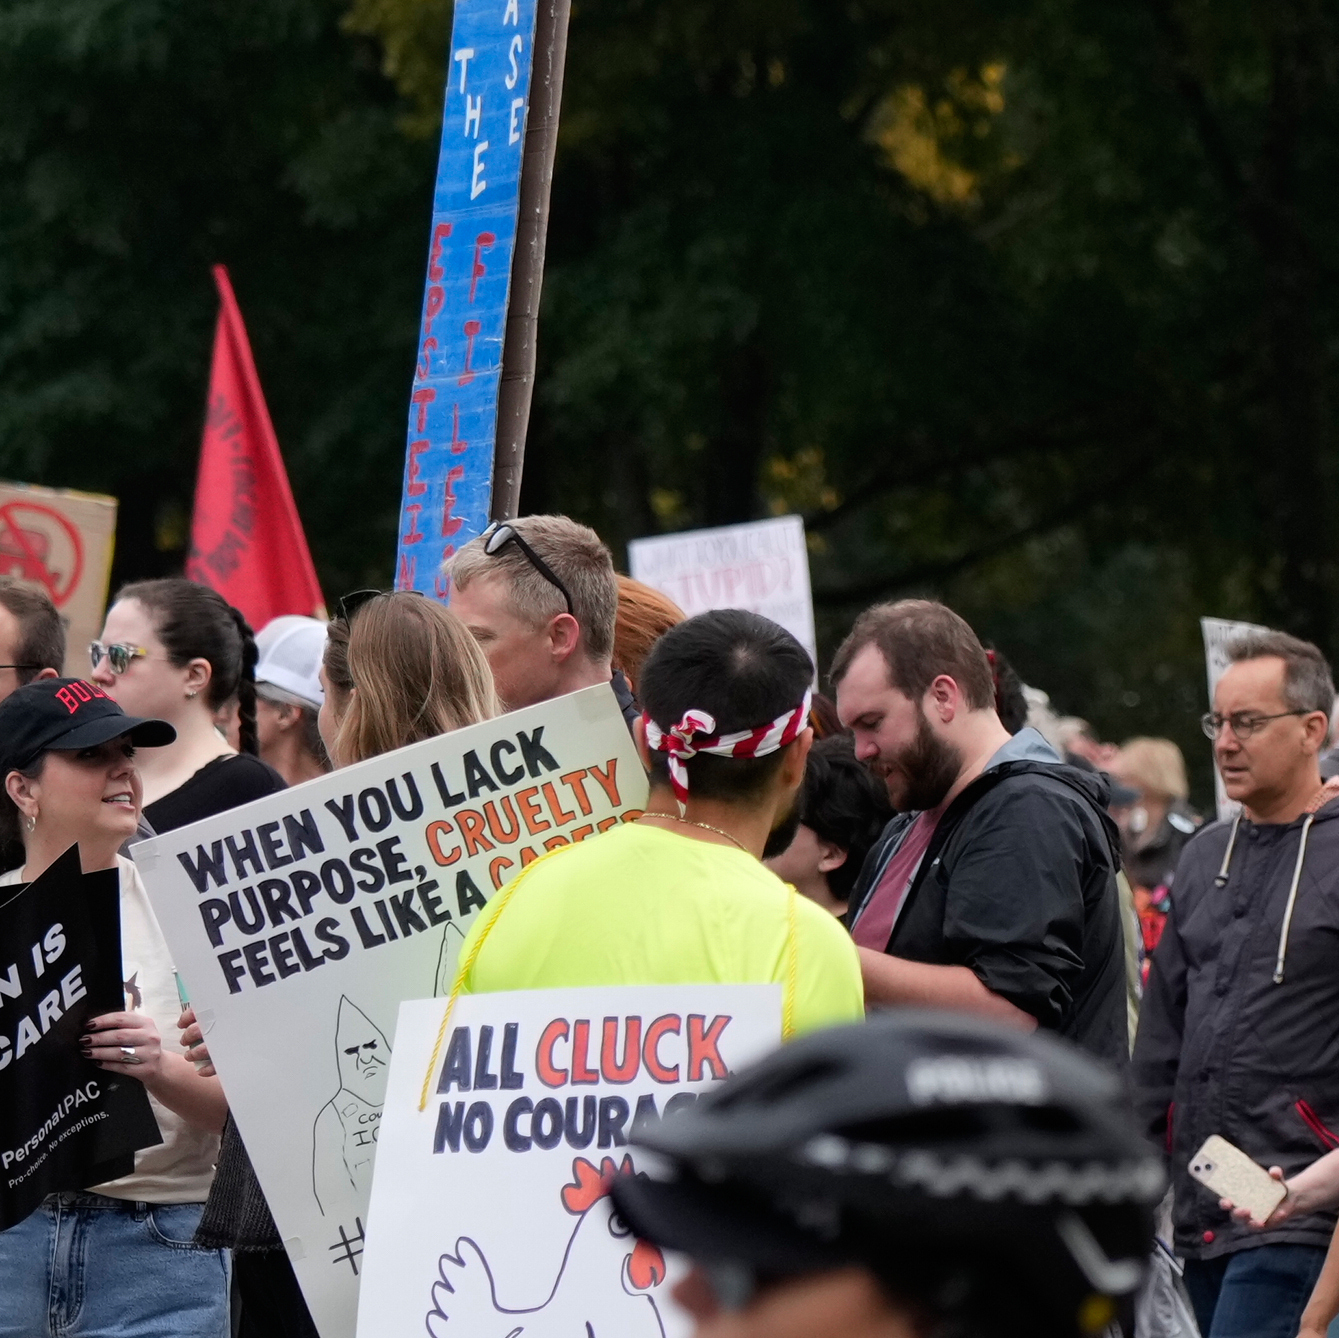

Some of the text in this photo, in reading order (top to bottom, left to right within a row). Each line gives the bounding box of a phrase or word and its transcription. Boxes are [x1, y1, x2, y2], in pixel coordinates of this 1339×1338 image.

[453, 48, 490, 201] THE
[398, 222, 452, 592] EPSTEIN
[177, 725, 561, 896] WHEN YOU LACK
[198, 834, 428, 949] PURPOSE,
[424, 757, 624, 868] CRUELTY
[31, 922, 67, 979] IS
[216, 867, 488, 996] FEELS LIKE A
[436, 1022, 525, 1095] ALL
[48, 1139, 59, 1152] No
[58, 1110, 110, 1142] exceptions.
[433, 1101, 494, 1155] NO
